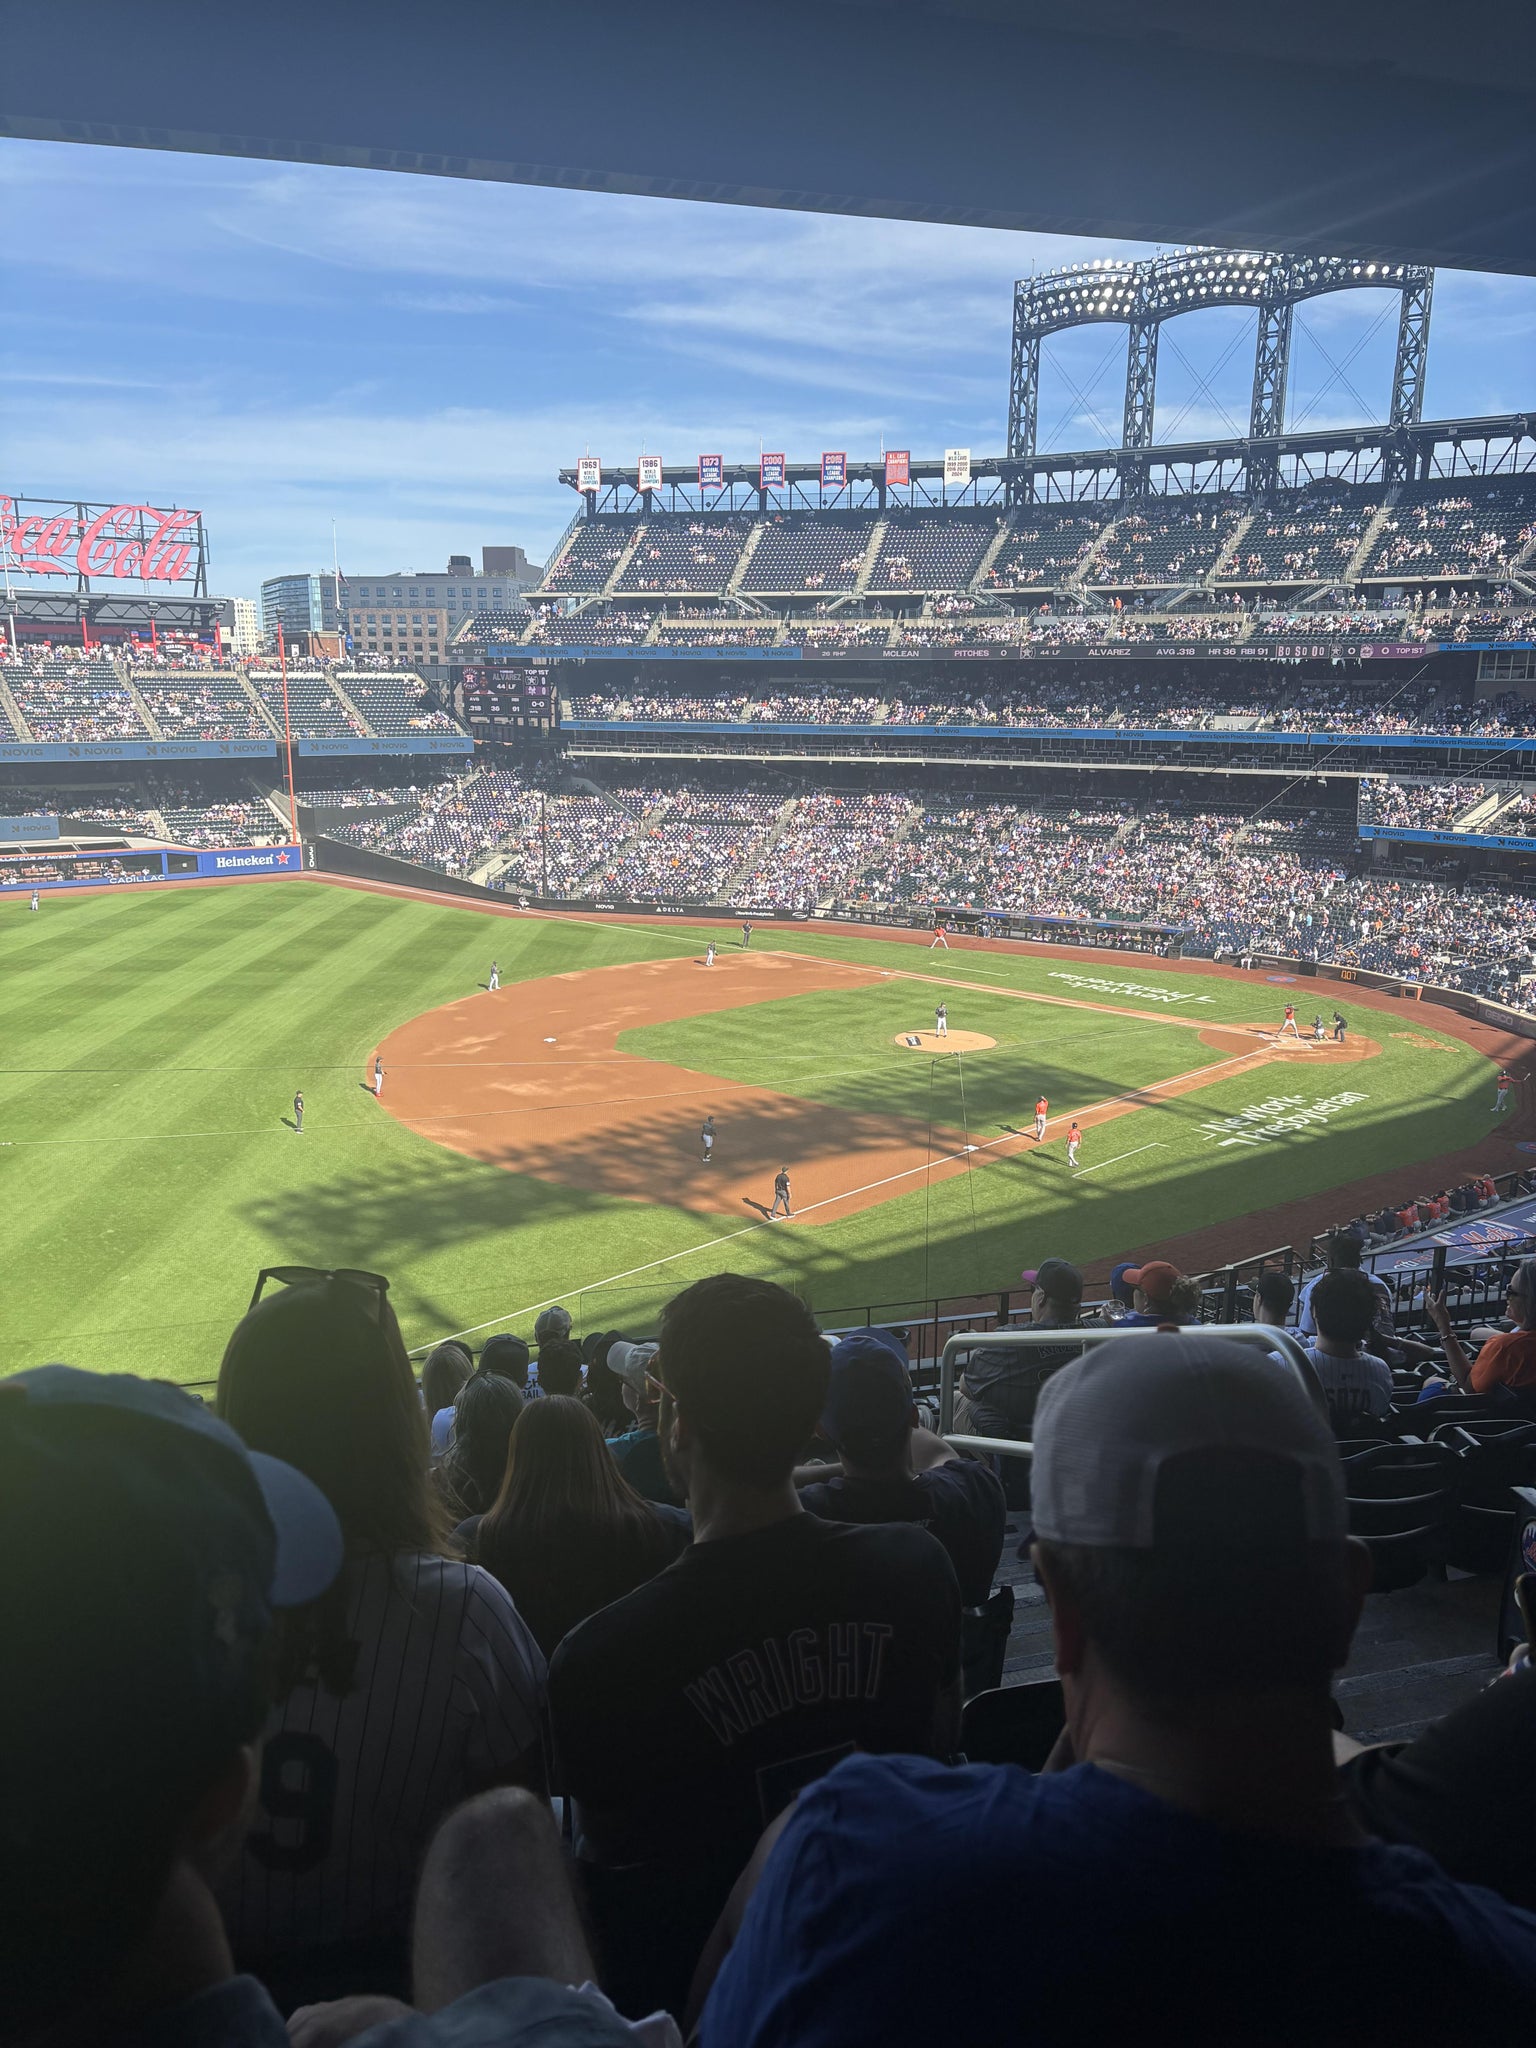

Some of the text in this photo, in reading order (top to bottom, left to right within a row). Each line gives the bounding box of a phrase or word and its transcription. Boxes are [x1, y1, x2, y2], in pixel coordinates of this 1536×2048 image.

[581, 460, 598, 469] 1969
[642, 459, 658, 468] 1986
[702, 457, 719, 467] 1973
[763, 455, 782, 465] 2000
[0, 494, 204, 581] oca-Cola
[1156, 648, 1175, 656] AVG
[1176, 648, 1195, 656] .318
[1208, 648, 1221, 656] HR
[1222, 648, 1237, 656] 36
[1240, 648, 1256, 656] RBI
[1257, 648, 1269, 656] 91
[493, 673, 521, 681] ALVAREZ
[86, 747, 123, 756] NOVIG
[161, 745, 198, 754] NOVIG
[233, 744, 268, 753] NOVIG
[321, 743, 349, 751] NOVIG
[2, 748, 44, 757] NOVIG
[216, 854, 274, 868] Heineken
[109, 874, 166, 885] CADILLAC
[1484, 1008, 1514, 1026] GEICO
[1236, 1091, 1370, 1142] Presbyterian
[1460, 1226, 1519, 1251] Mets
[1325, 1388, 1371, 1410] SOTO
[682, 1621, 894, 1747] WRIGHT
[249, 1731, 340, 1874] 9
